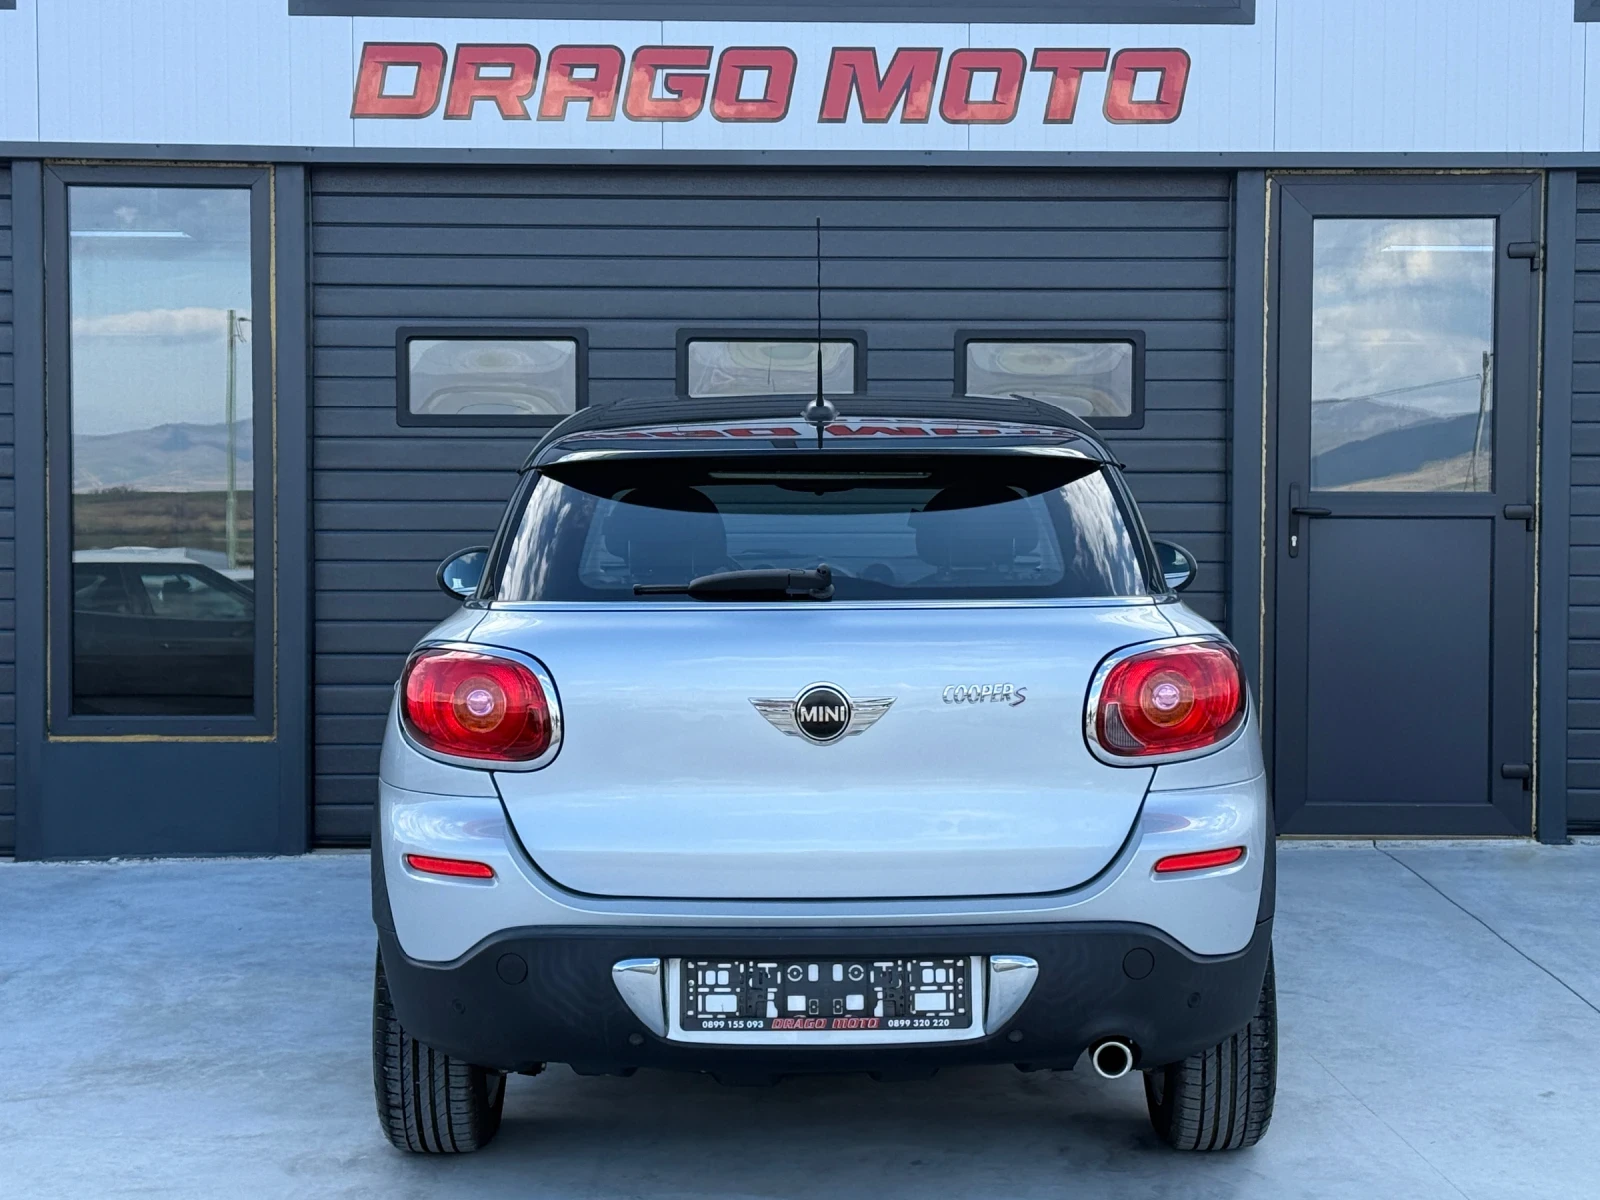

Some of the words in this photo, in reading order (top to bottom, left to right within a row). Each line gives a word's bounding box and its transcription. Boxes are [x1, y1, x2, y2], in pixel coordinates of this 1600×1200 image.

[351, 41, 798, 124] DRAGO
[818, 46, 1192, 125] MOTO
[942, 683, 1015, 705] COOPER
[800, 705, 845, 723] MINI
[702, 1020, 725, 1029] 0899
[728, 1020, 744, 1029] 155
[746, 1020, 764, 1029] 093
[771, 1018, 827, 1029] DRAGO
[832, 1017, 879, 1029] MOTO
[888, 1019, 911, 1027] 0899
[913, 1019, 930, 1027] 320
[933, 1018, 950, 1027] 220
